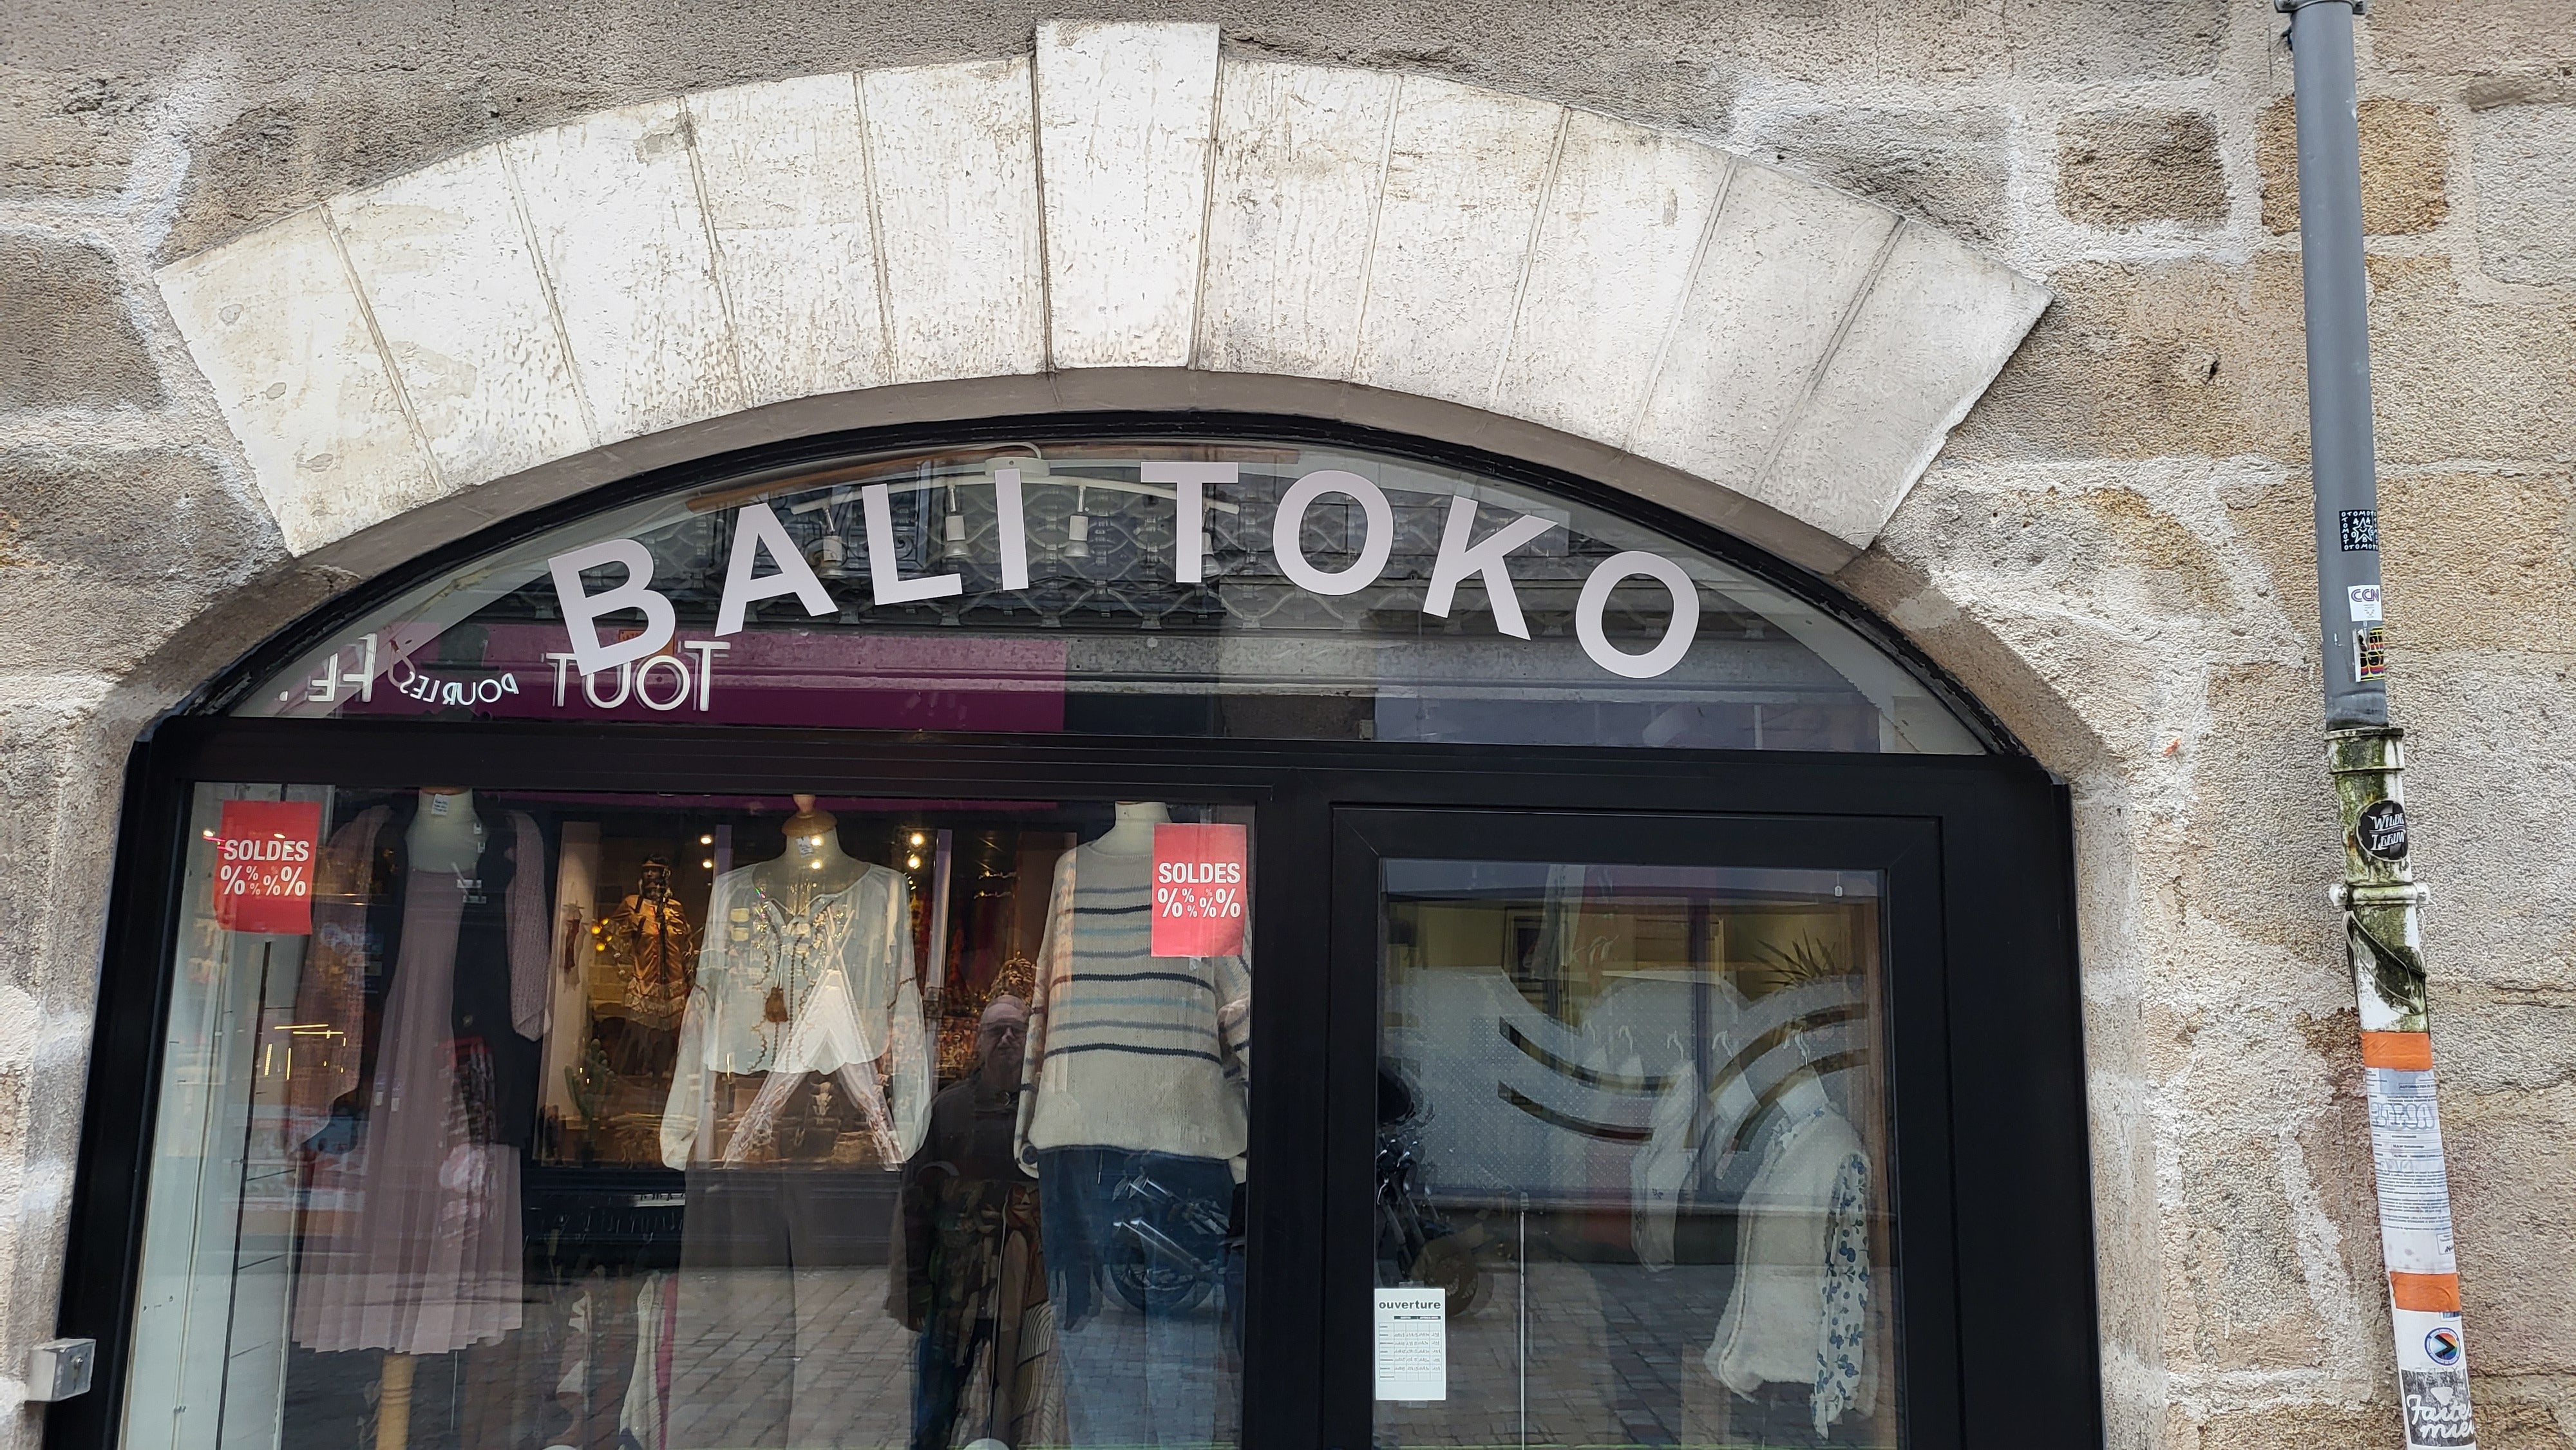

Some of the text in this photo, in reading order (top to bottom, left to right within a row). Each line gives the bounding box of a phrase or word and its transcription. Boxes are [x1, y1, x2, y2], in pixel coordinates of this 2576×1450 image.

[548, 462, 1700, 679] BALI TOKO
[2351, 588, 2379, 602] CCN
[2367, 813, 2404, 830] WILDE
[2370, 832, 2404, 850] LEEUW
[223, 840, 309, 862] SOLDES
[1158, 863, 1240, 883] SOLDES
[1379, 1300, 1441, 1309] ouverture
